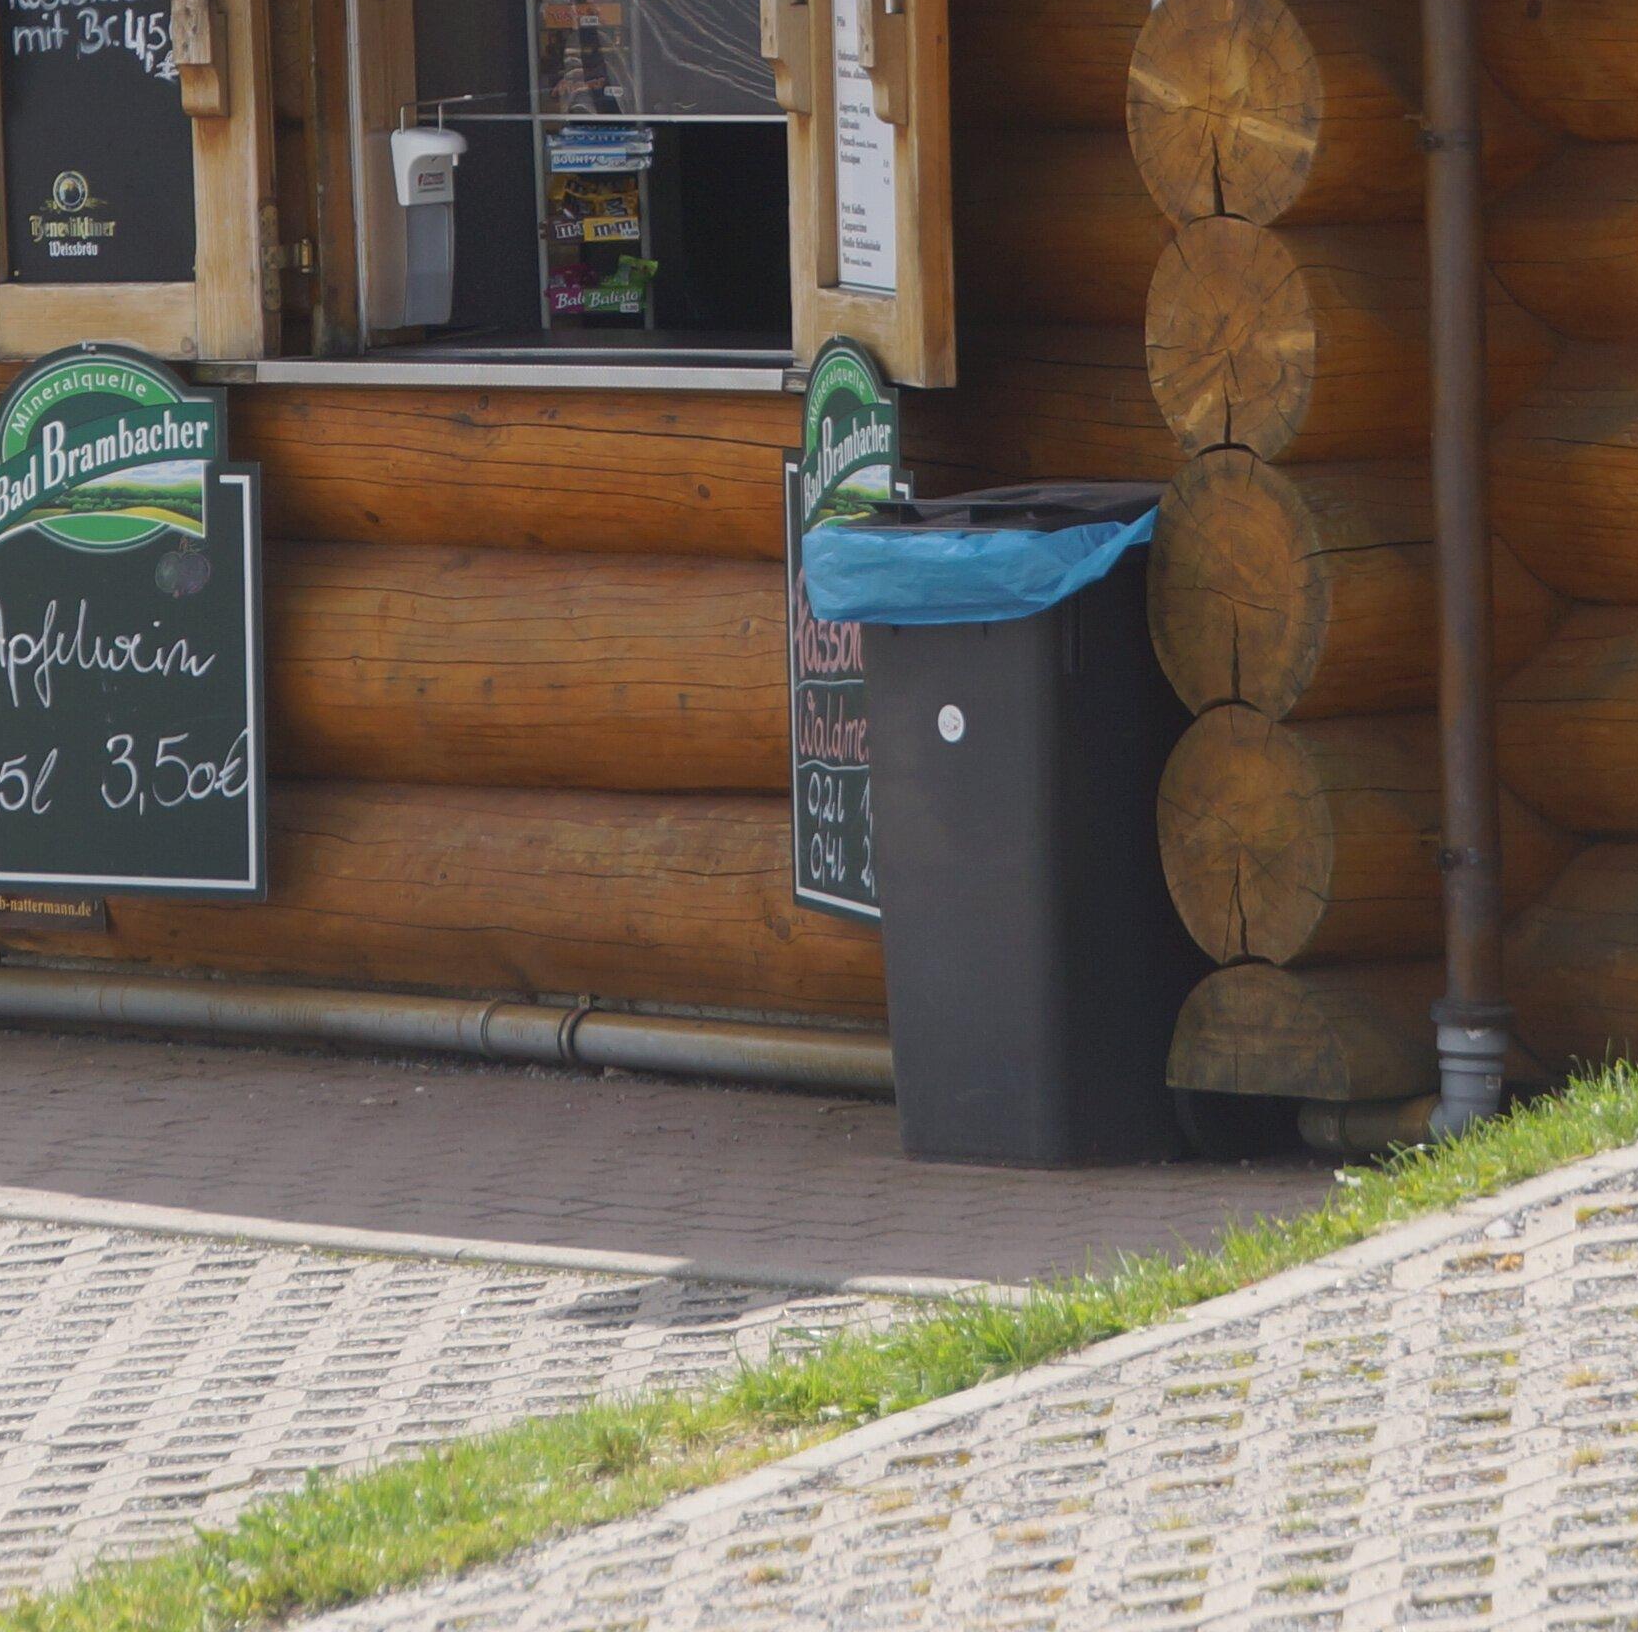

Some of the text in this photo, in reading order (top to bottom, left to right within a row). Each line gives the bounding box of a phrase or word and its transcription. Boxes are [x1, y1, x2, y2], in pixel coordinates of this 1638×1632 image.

[14, 9, 70, 57] mit
[553, 154, 597, 166] BOUNTY
[11, 371, 148, 437] Mineralquelle
[809, 367, 866, 429] Mineralquelle
[42, 409, 210, 491] Brambacher
[803, 410, 892, 522] Bad Brambacher
